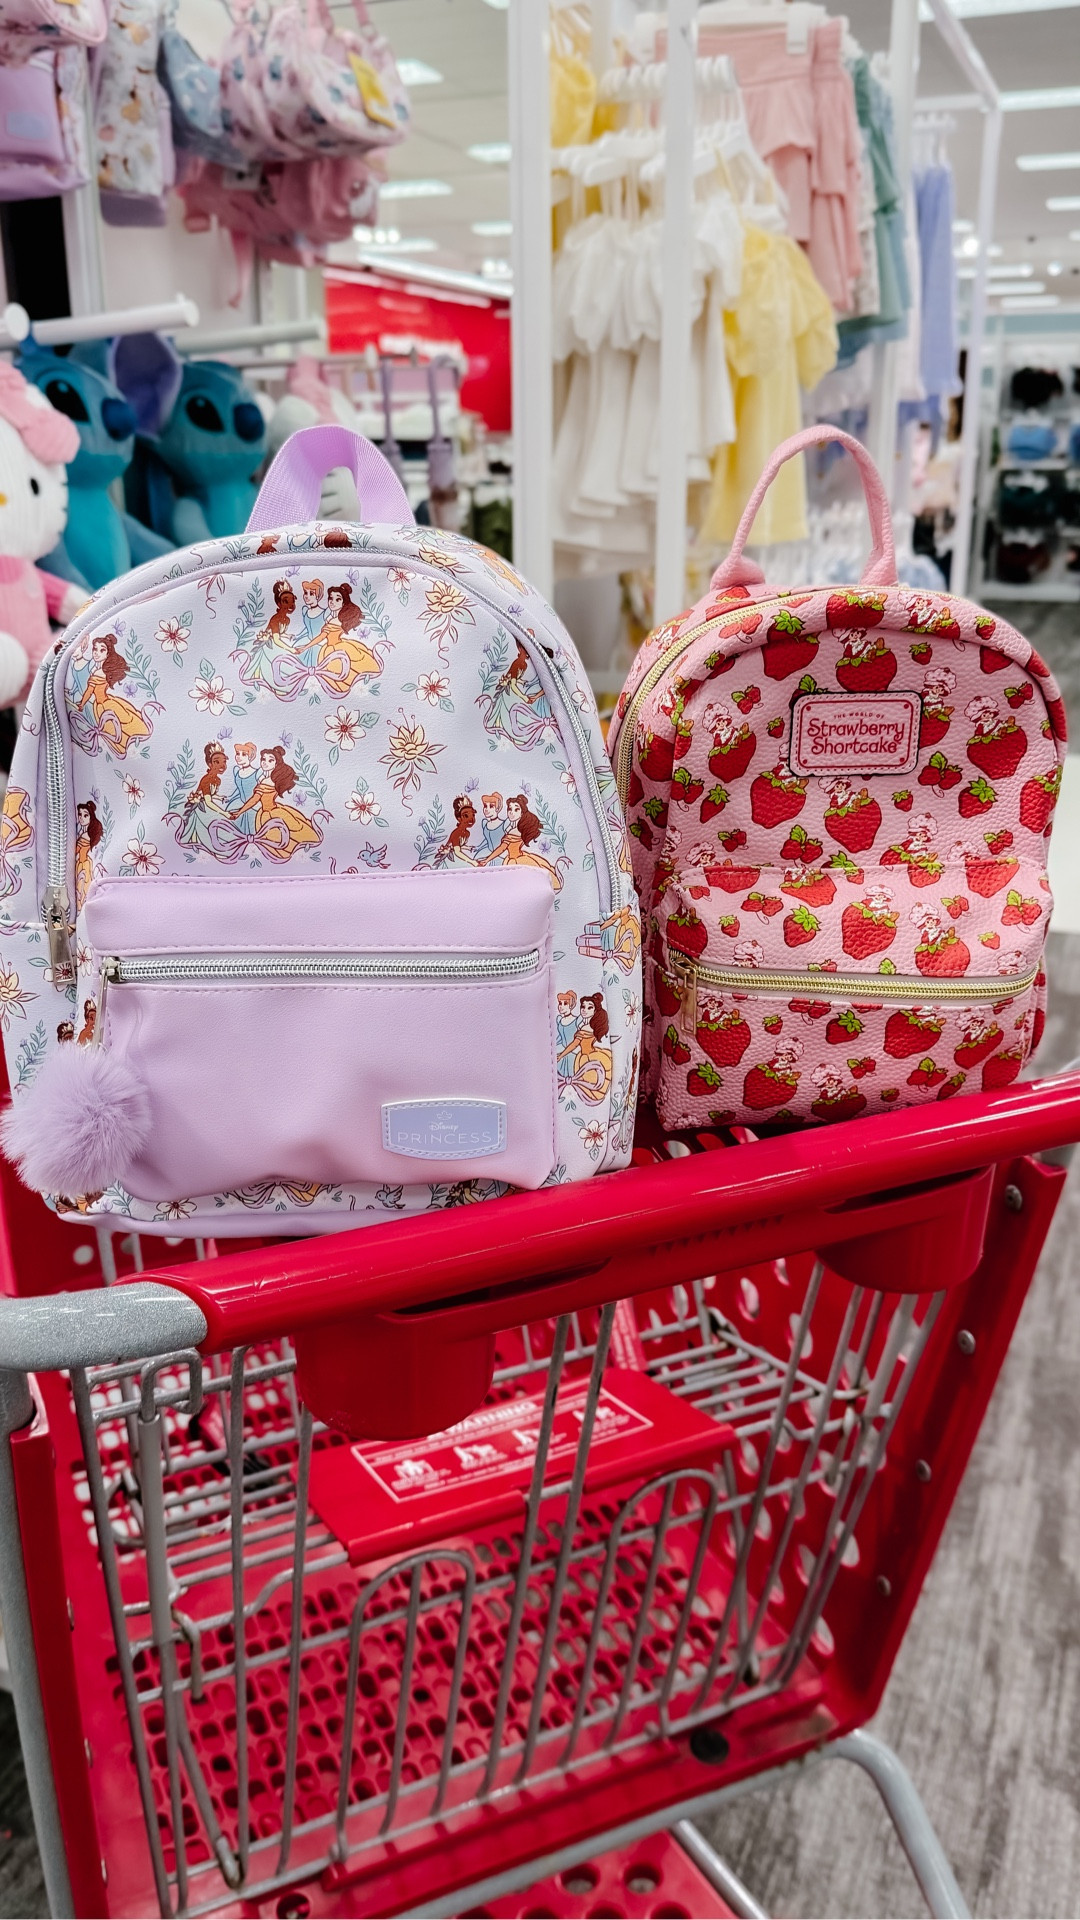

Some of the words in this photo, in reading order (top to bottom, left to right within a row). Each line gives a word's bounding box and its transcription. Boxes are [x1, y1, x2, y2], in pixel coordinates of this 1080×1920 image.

[807, 718, 905, 742] Strawberry
[811, 737, 898, 755] Shortcake
[428, 1121, 459, 1133] Disney
[397, 1131, 492, 1145] PRINCESS
